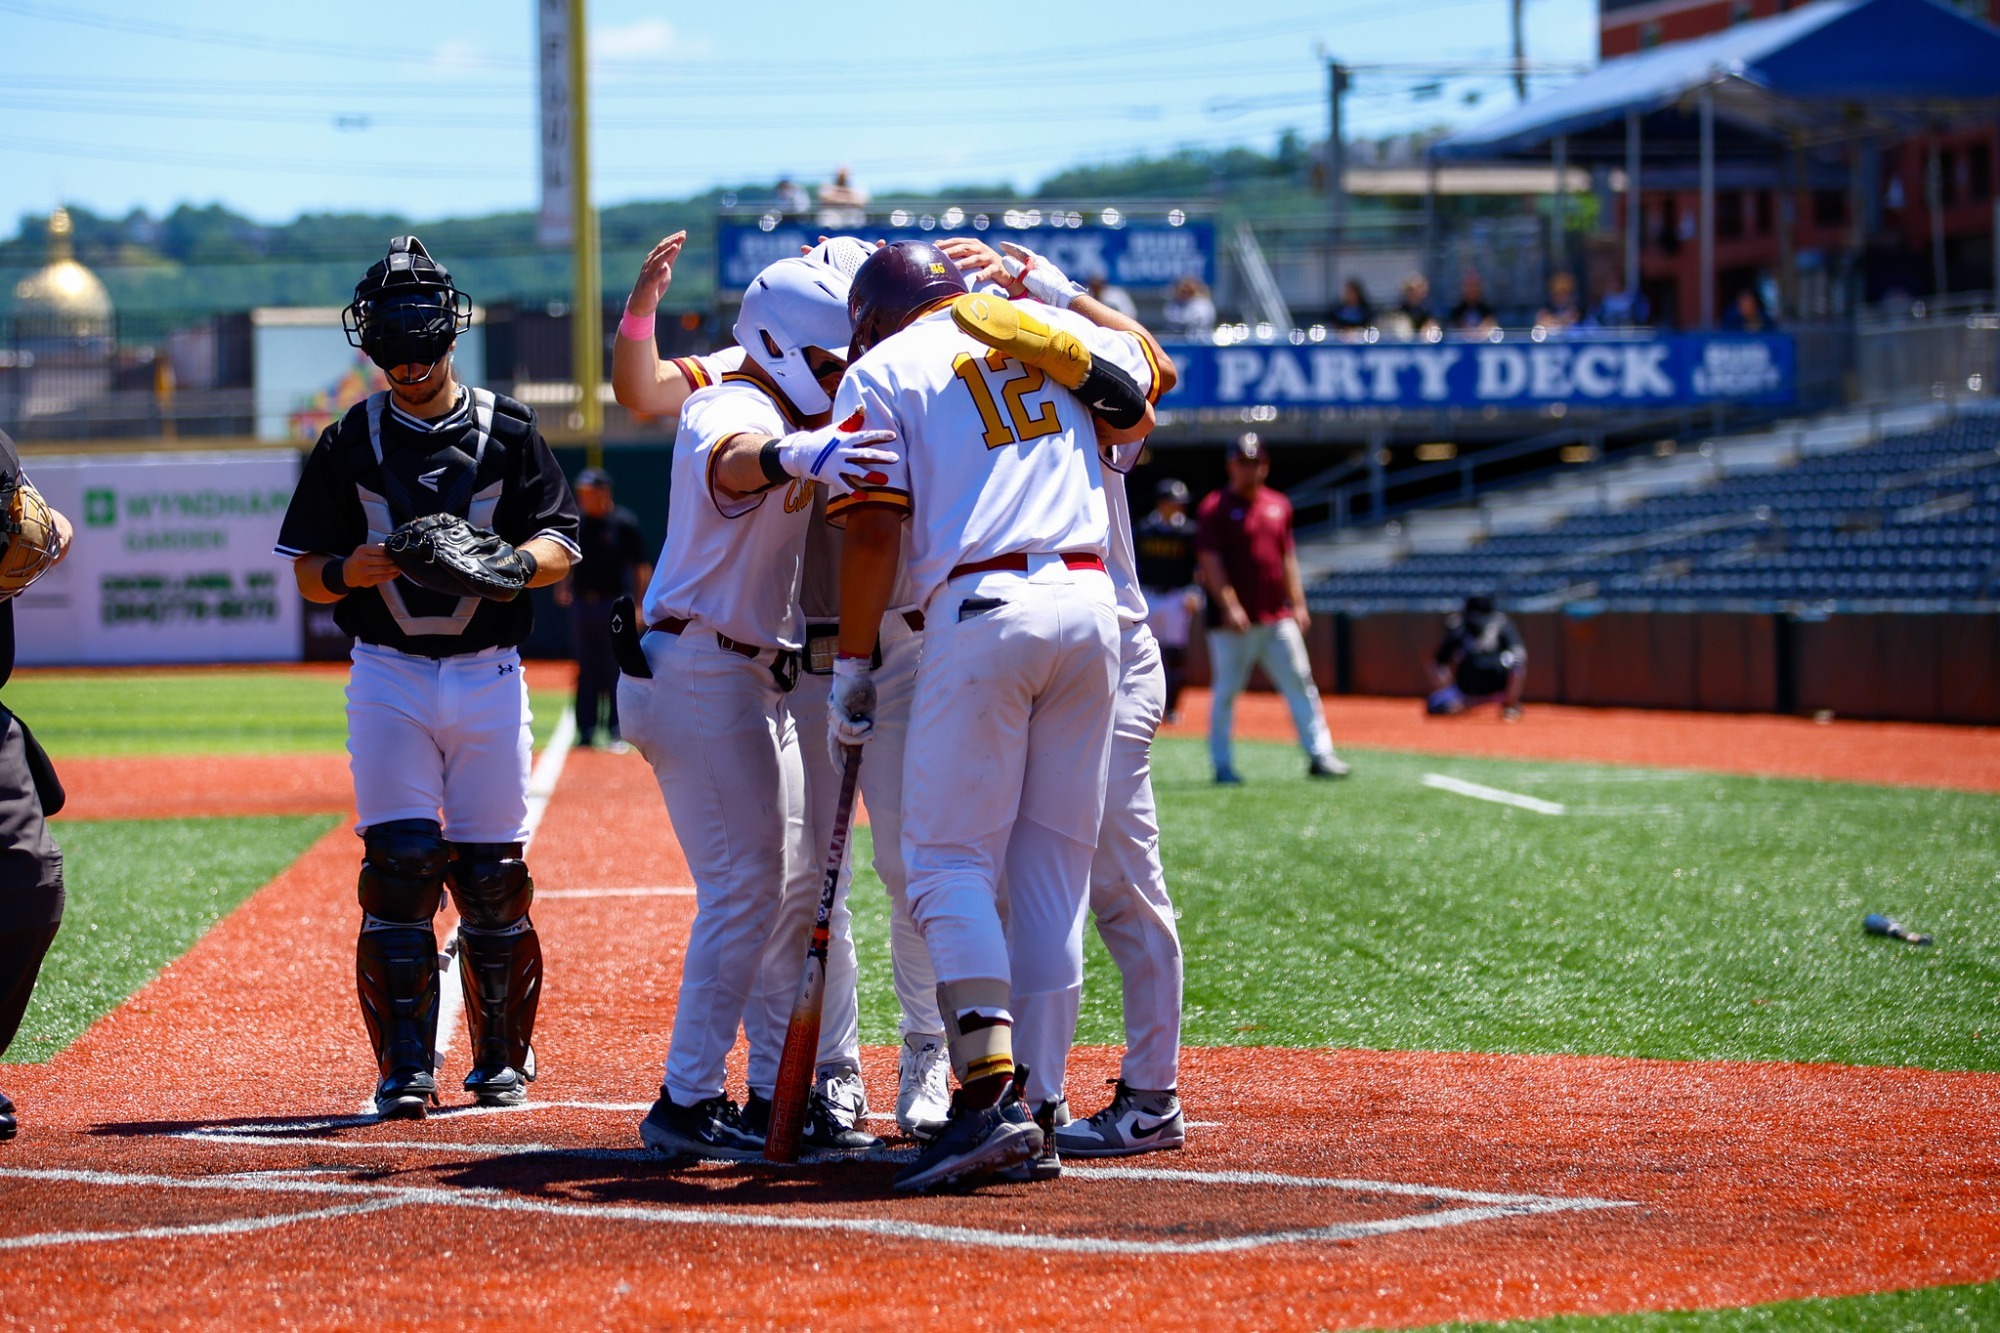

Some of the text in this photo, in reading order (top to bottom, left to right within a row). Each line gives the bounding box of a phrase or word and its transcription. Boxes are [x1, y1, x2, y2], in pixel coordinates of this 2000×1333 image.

[951, 347, 1063, 450] 12
[1218, 348, 1459, 399] PARTY
[1476, 347, 1673, 397] DECK
